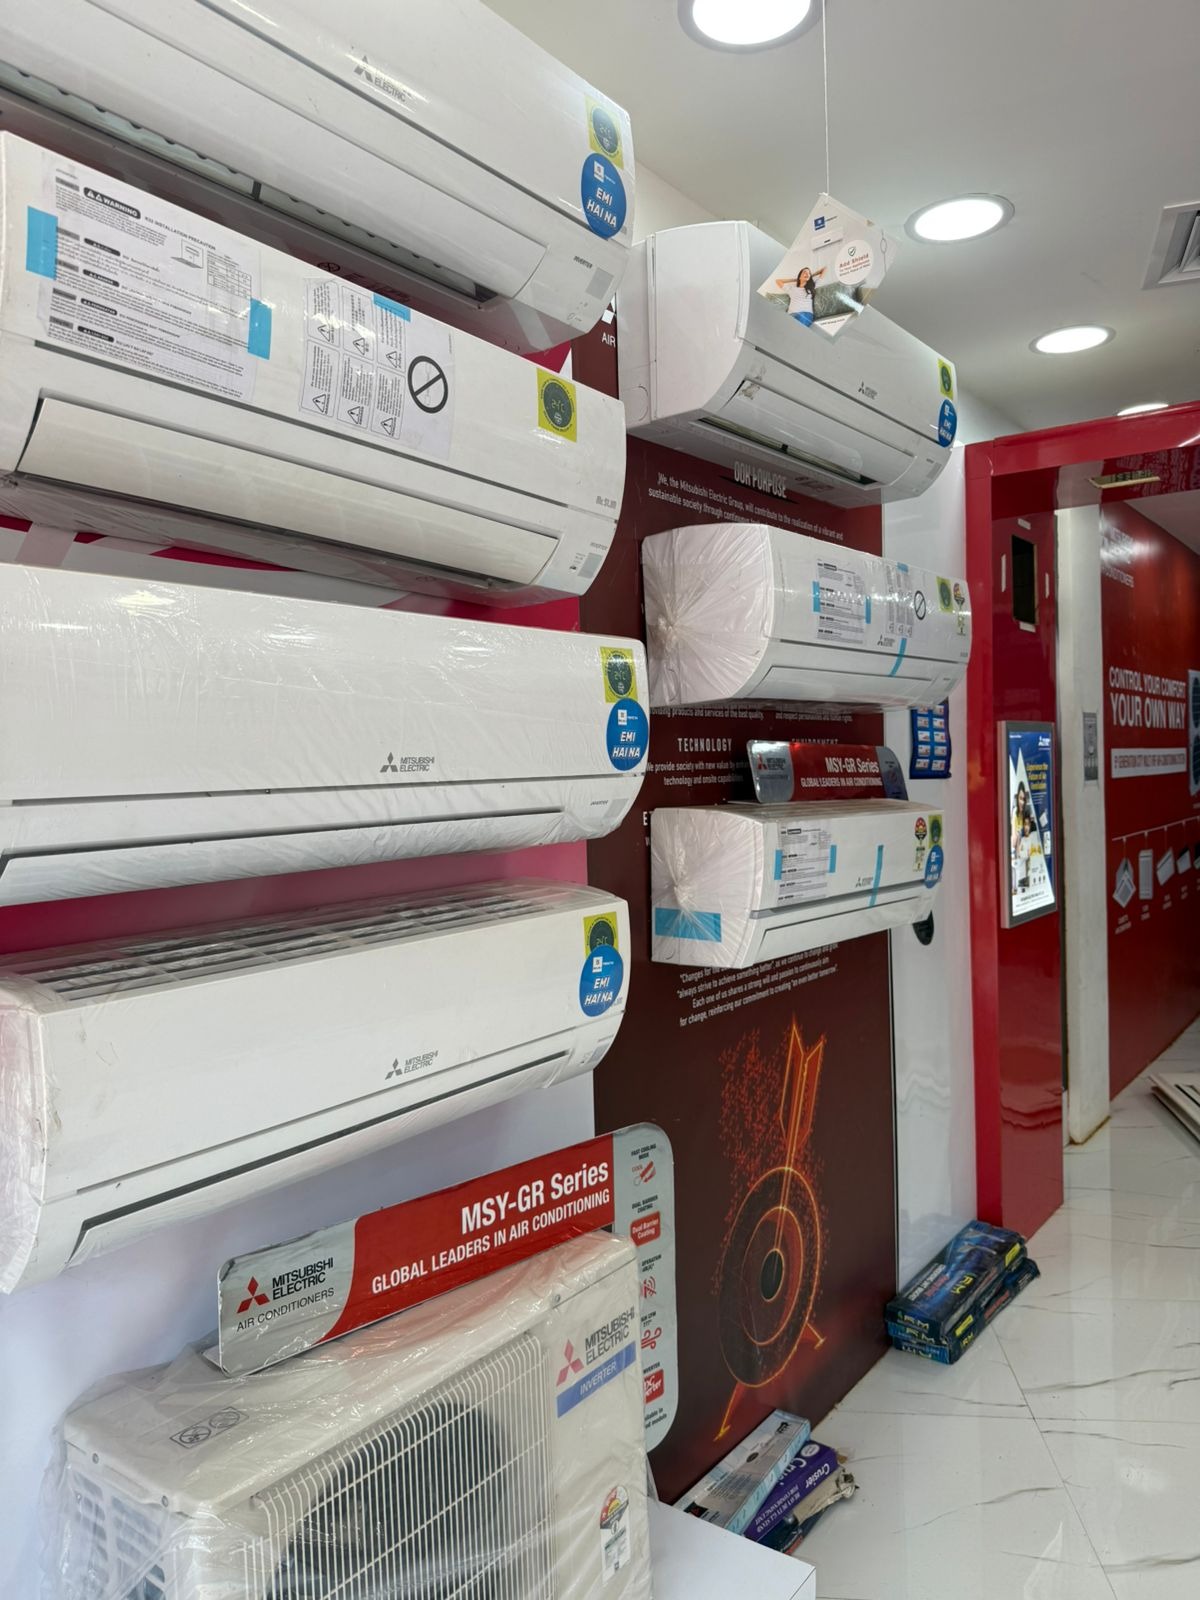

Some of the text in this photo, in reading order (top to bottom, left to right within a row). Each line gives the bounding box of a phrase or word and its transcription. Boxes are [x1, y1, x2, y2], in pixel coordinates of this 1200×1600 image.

[375, 77, 405, 102] ELECTRIC
[596, 187, 612, 206] EMI
[102, 197, 139, 218] WARNING
[587, 200, 617, 227] HAI NA
[574, 255, 592, 269] INVERTER
[602, 332, 616, 346] AIR
[648, 488, 682, 504] sustainable
[682, 498, 702, 514] society
[703, 503, 723, 519] through
[670, 476, 679, 488] the
[680, 480, 708, 497] Mitsubishi
[709, 489, 728, 504] Electric
[728, 496, 744, 511] Group,
[745, 503, 754, 512] will
[755, 506, 777, 520] contribute
[1109, 666, 1186, 698] CONTROL YOUR COMFORT
[1110, 692, 1186, 729] YOUR OWN WAY
[620, 731, 636, 742] EMI
[678, 738, 732, 752] TECHNOLOGY
[400, 756, 434, 764] MITSUBISHI
[612, 748, 641, 758] HAI NA
[400, 764, 430, 772] ELECTRIC
[655, 761, 675, 773] provide
[676, 761, 694, 772] society
[695, 761, 705, 769] with
[825, 757, 880, 773] MSY-GR Series
[664, 774, 717, 786] technology and onsite
[800, 777, 819, 788] GLOBAL
[820, 777, 840, 787] LEADERS
[854, 777, 883, 786] CONDITIONING
[594, 977, 610, 989] EMI
[692, 996, 705, 1008] Each
[706, 994, 715, 1004] one
[715, 991, 721, 1000] of
[728, 986, 744, 996] shares
[748, 979, 762, 990] strong
[762, 974, 770, 984] will
[779, 968, 794, 980] passion
[698, 981, 712, 993] strive
[718, 975, 736, 986] achieve
[736, 967, 759, 980] something
[584, 991, 613, 1005] HAI NA
[688, 1011, 708, 1024] change,
[708, 1002, 734, 1016] reinforcing
[734, 999, 742, 1008] our
[742, 988, 769, 1005] commitment
[774, 982, 791, 993] creating
[798, 976, 807, 984] even
[808, 972, 818, 981] better
[404, 1060, 432, 1074] ELECTRIC
[405, 1050, 438, 1066] MITSUBISHI
[461, 1161, 608, 1235] MSY-GR Series
[632, 1218, 659, 1234] Dual Barrier
[637, 1228, 655, 1239] Coating
[372, 1188, 610, 1294] GLOBAL LEADERS IN AIR CONDITIONING
[272, 1257, 334, 1288] MITSUBISHI
[272, 1272, 326, 1300] ELECTRIC
[236, 1288, 335, 1332] AIR CONDITIONERS
[585, 1306, 634, 1352] MITSUBISHI
[586, 1325, 629, 1366] ELECTRIC
[580, 1361, 617, 1396] INVERTER
[805, 1463, 830, 1489] Crusier
